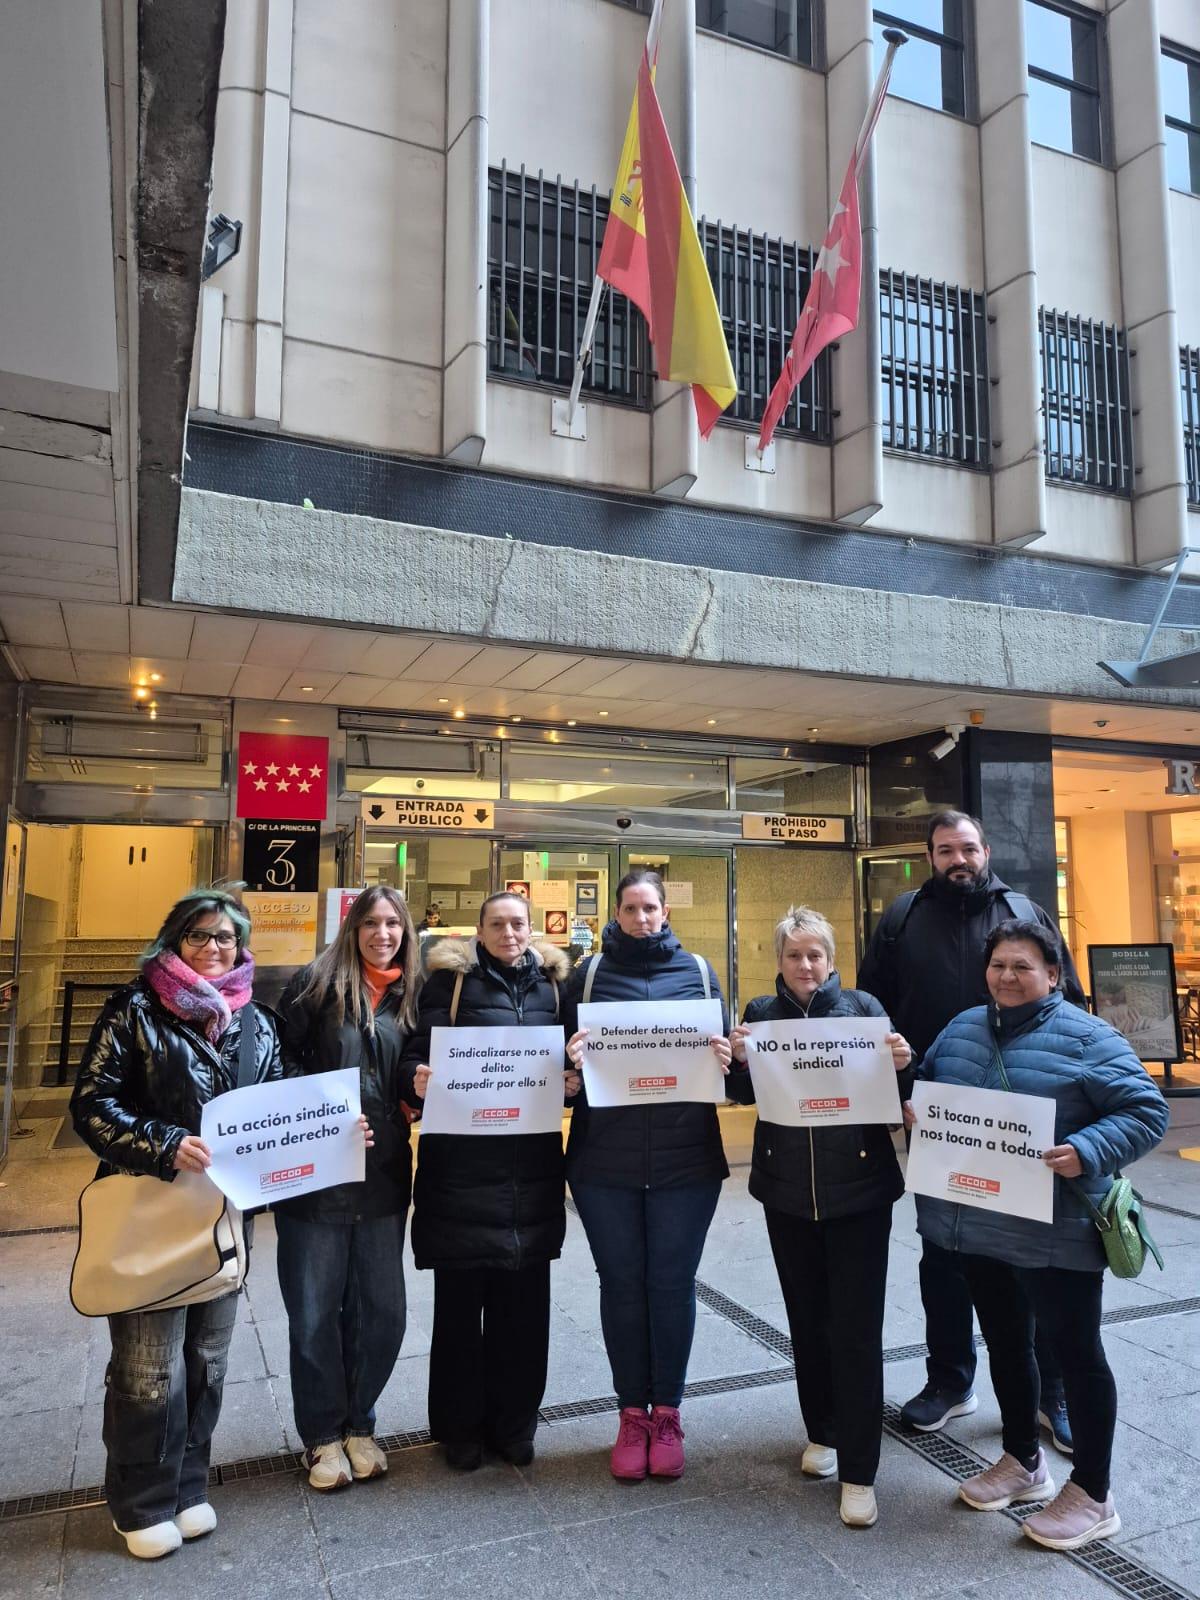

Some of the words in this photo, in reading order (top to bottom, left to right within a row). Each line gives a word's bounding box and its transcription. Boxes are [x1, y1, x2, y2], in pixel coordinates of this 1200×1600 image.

[395, 800, 465, 813] ENTRADA
[398, 812, 463, 826] PÚBLICO
[764, 816, 827, 828] PROHIBIDO
[248, 823, 256, 831] C/
[280, 824, 317, 832] PRINCESA
[771, 827, 785, 837] EL
[788, 828, 818, 838] PASO
[266, 839, 297, 886] 3
[251, 903, 311, 914] ACCESO
[601, 1026, 648, 1036] Defender
[651, 1024, 698, 1035] derechos
[587, 1042, 604, 1051] NO
[620, 1040, 657, 1050] motivo
[659, 1039, 673, 1048] de
[756, 1041, 778, 1052] NO
[781, 1043, 790, 1051] a
[794, 1038, 807, 1051] la
[811, 1037, 875, 1052] represión
[449, 1047, 522, 1058] Sindicalizarse
[524, 1049, 537, 1057] no
[539, 1048, 550, 1056] es
[481, 1062, 514, 1073] delito:
[792, 1055, 844, 1070] sindical
[447, 1078, 494, 1092] despedir
[496, 1079, 515, 1091] por
[517, 1077, 536, 1087] ello
[538, 1077, 547, 1087] sí
[217, 1122, 238, 1137] La
[242, 1113, 292, 1132] acción
[295, 1098, 350, 1122] sindical
[927, 1105, 941, 1120] Si
[944, 1109, 980, 1126] tocan
[984, 1118, 994, 1128] a
[998, 1119, 1033, 1137] una,
[235, 1144, 252, 1155] es
[257, 1138, 276, 1151] un
[280, 1125, 340, 1146] derecho
[920, 1128, 943, 1141] nos
[946, 1131, 982, 1149] tocan
[986, 1140, 996, 1151] a
[1001, 1140, 1042, 1159] todas
